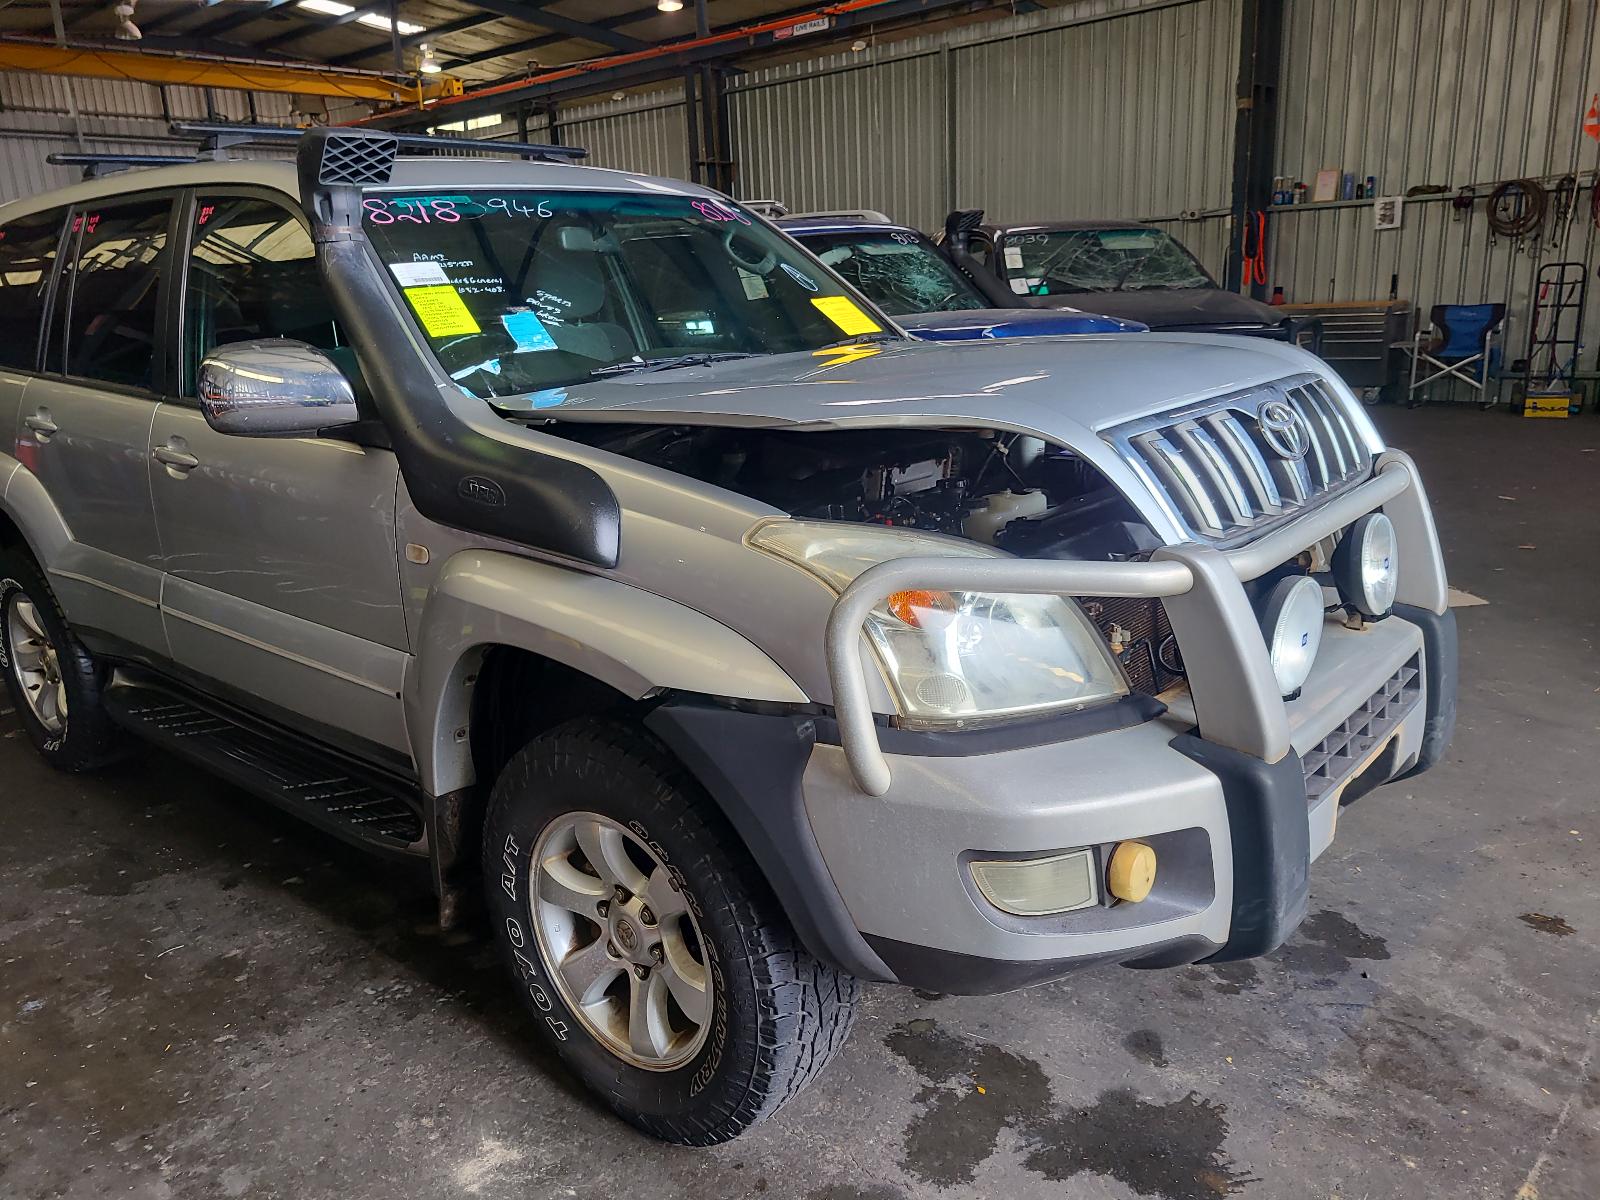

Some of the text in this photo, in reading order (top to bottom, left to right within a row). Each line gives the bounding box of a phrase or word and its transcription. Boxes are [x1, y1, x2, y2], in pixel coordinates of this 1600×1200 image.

[362, 198, 461, 225] 8218
[500, 832, 570, 1042] TOYO A/T
